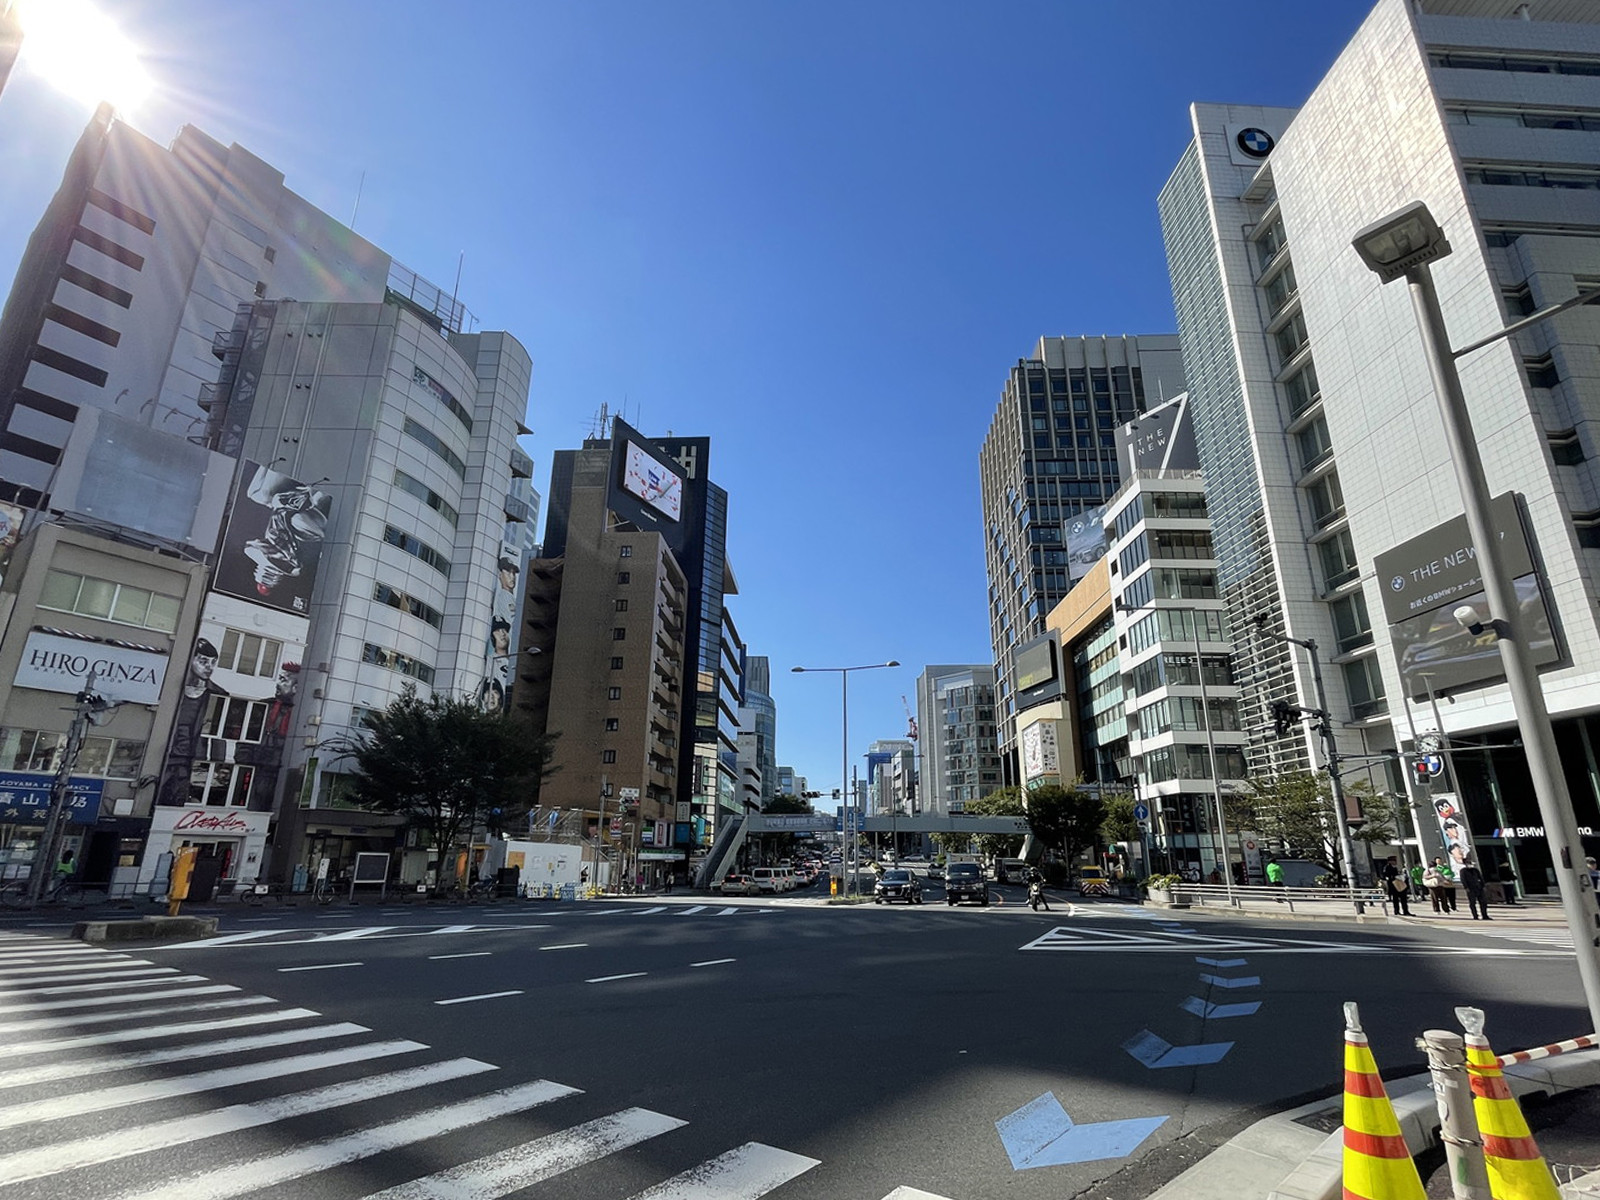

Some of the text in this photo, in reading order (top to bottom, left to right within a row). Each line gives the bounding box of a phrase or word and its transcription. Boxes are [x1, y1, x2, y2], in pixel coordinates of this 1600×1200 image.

[1137, 428, 1164, 446] THE
[1138, 437, 1166, 456] NEW
[1410, 560, 1441, 582] THE
[1443, 546, 1478, 569] NEW
[30, 649, 157, 685] HIRO GINZA
[0, 780, 39, 788] AOYAMA
[1516, 826, 1545, 838] BMW
